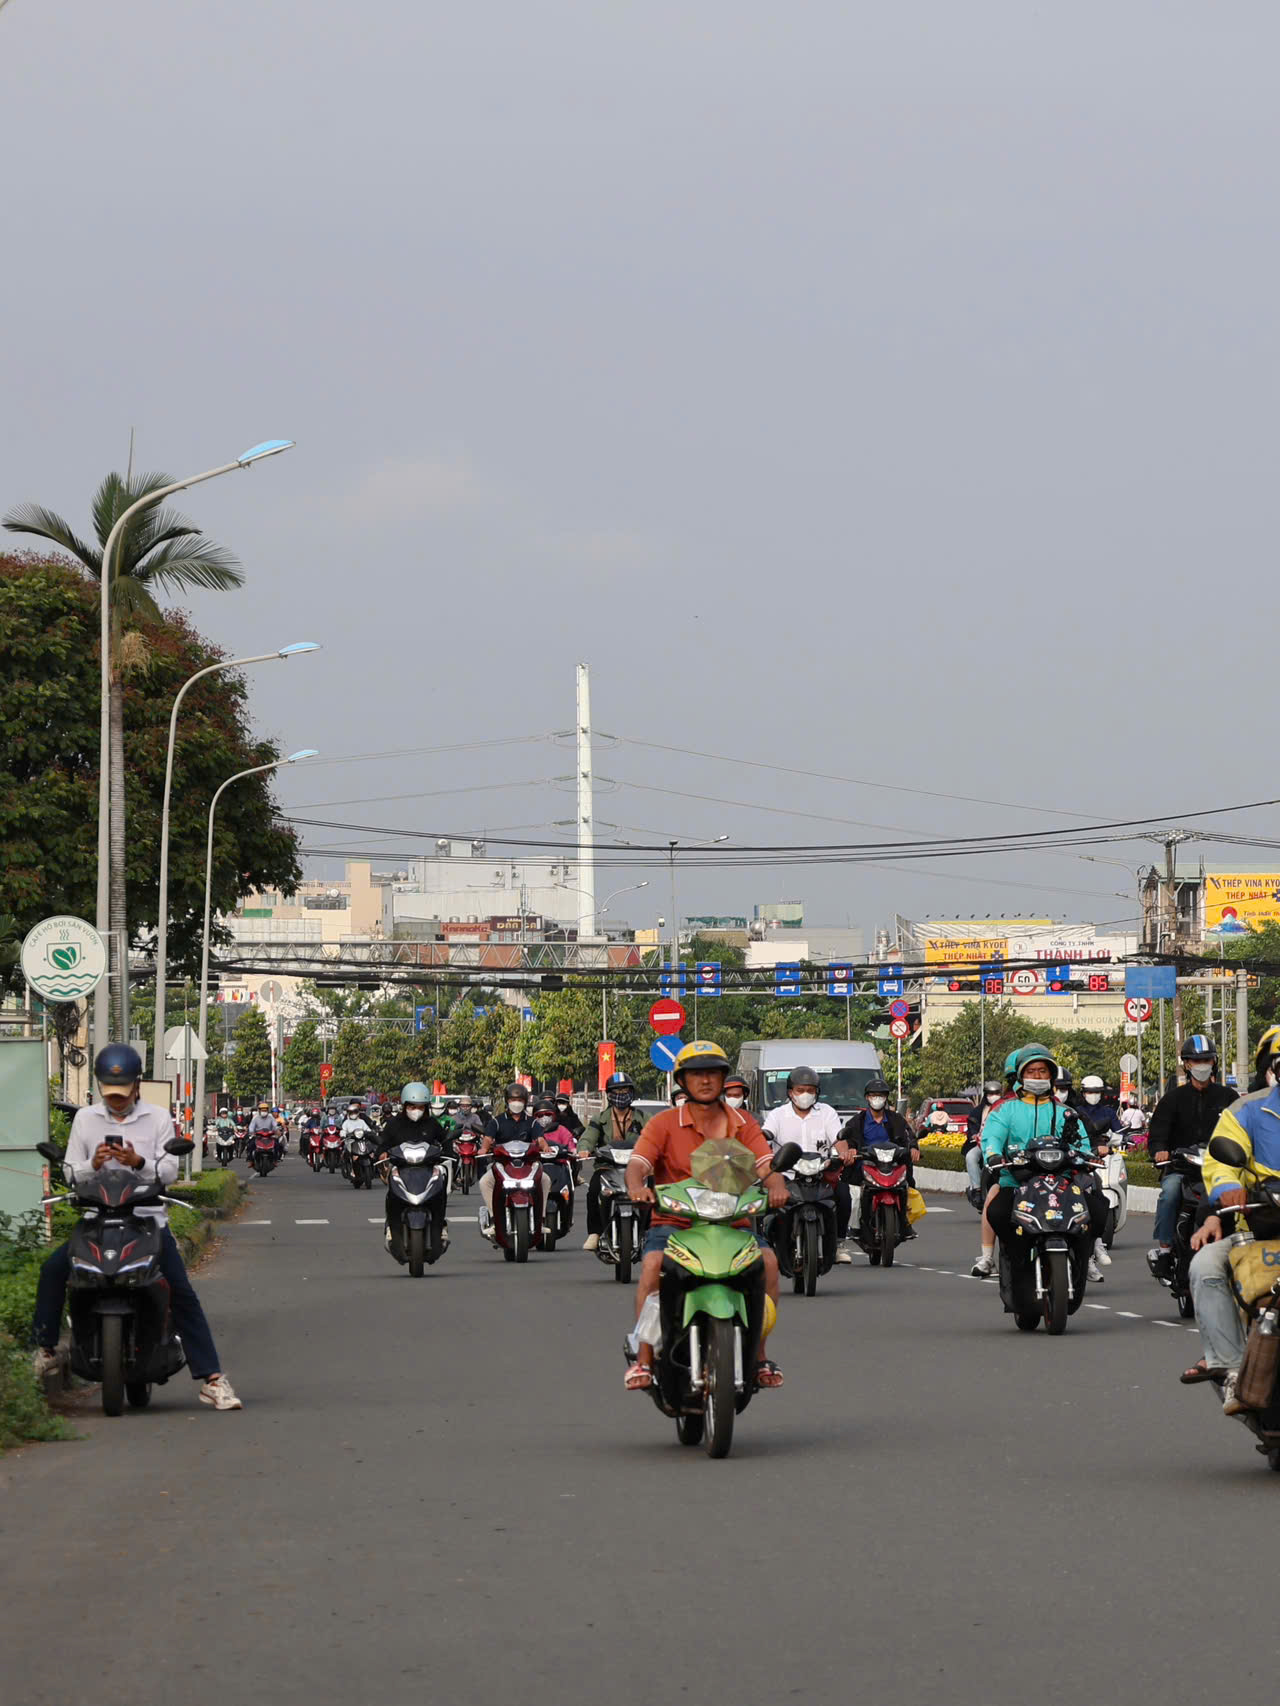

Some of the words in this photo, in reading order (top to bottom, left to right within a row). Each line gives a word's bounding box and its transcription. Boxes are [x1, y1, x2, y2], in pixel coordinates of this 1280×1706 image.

[1222, 878, 1242, 887] THÉP
[1245, 879, 1262, 887] VINA
[1226, 891, 1245, 899] THÉP
[983, 940, 1007, 949] KYOEI
[1050, 939, 1066, 947] CÔNG
[1089, 975, 1108, 991] 85
